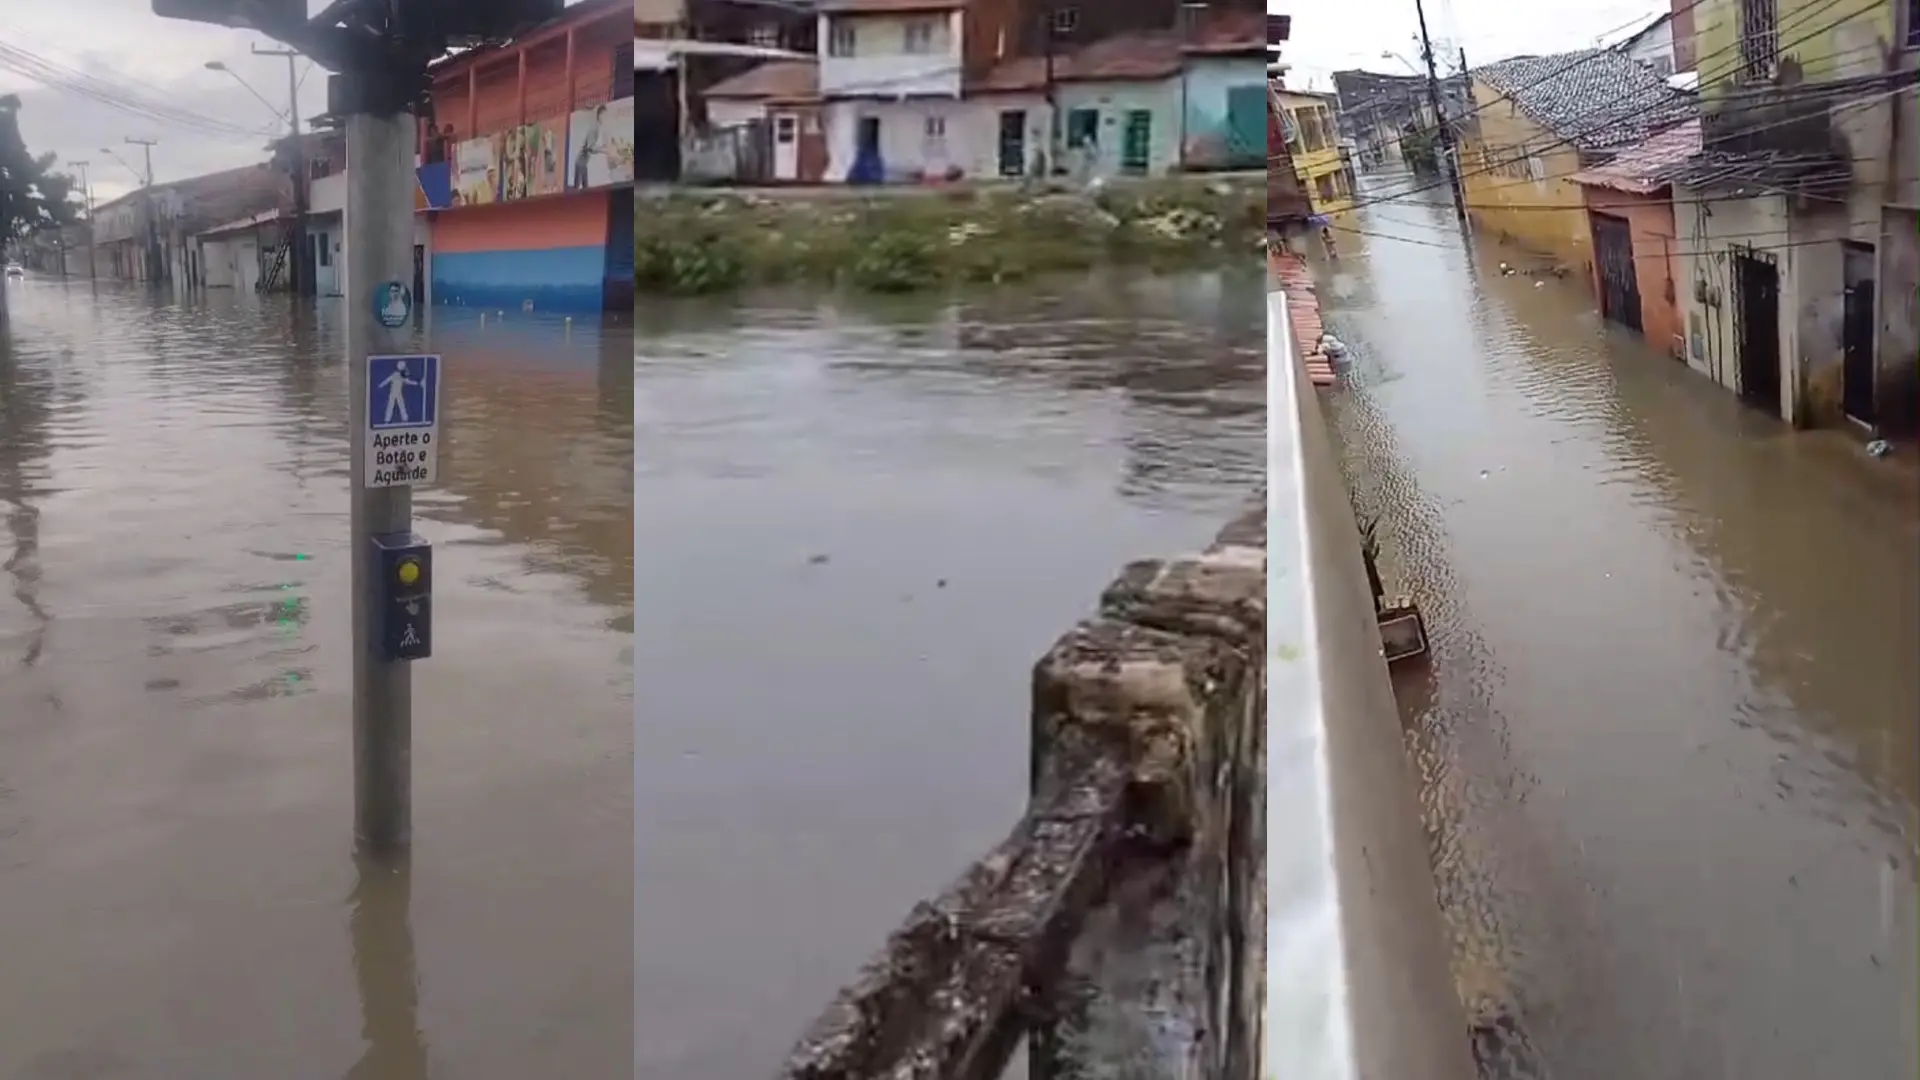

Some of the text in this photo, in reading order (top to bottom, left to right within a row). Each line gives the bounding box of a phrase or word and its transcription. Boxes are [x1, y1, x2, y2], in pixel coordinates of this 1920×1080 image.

[373, 432, 430, 450] Aperte o
[376, 449, 427, 465] Botão e
[374, 466, 428, 484] Aguarde
